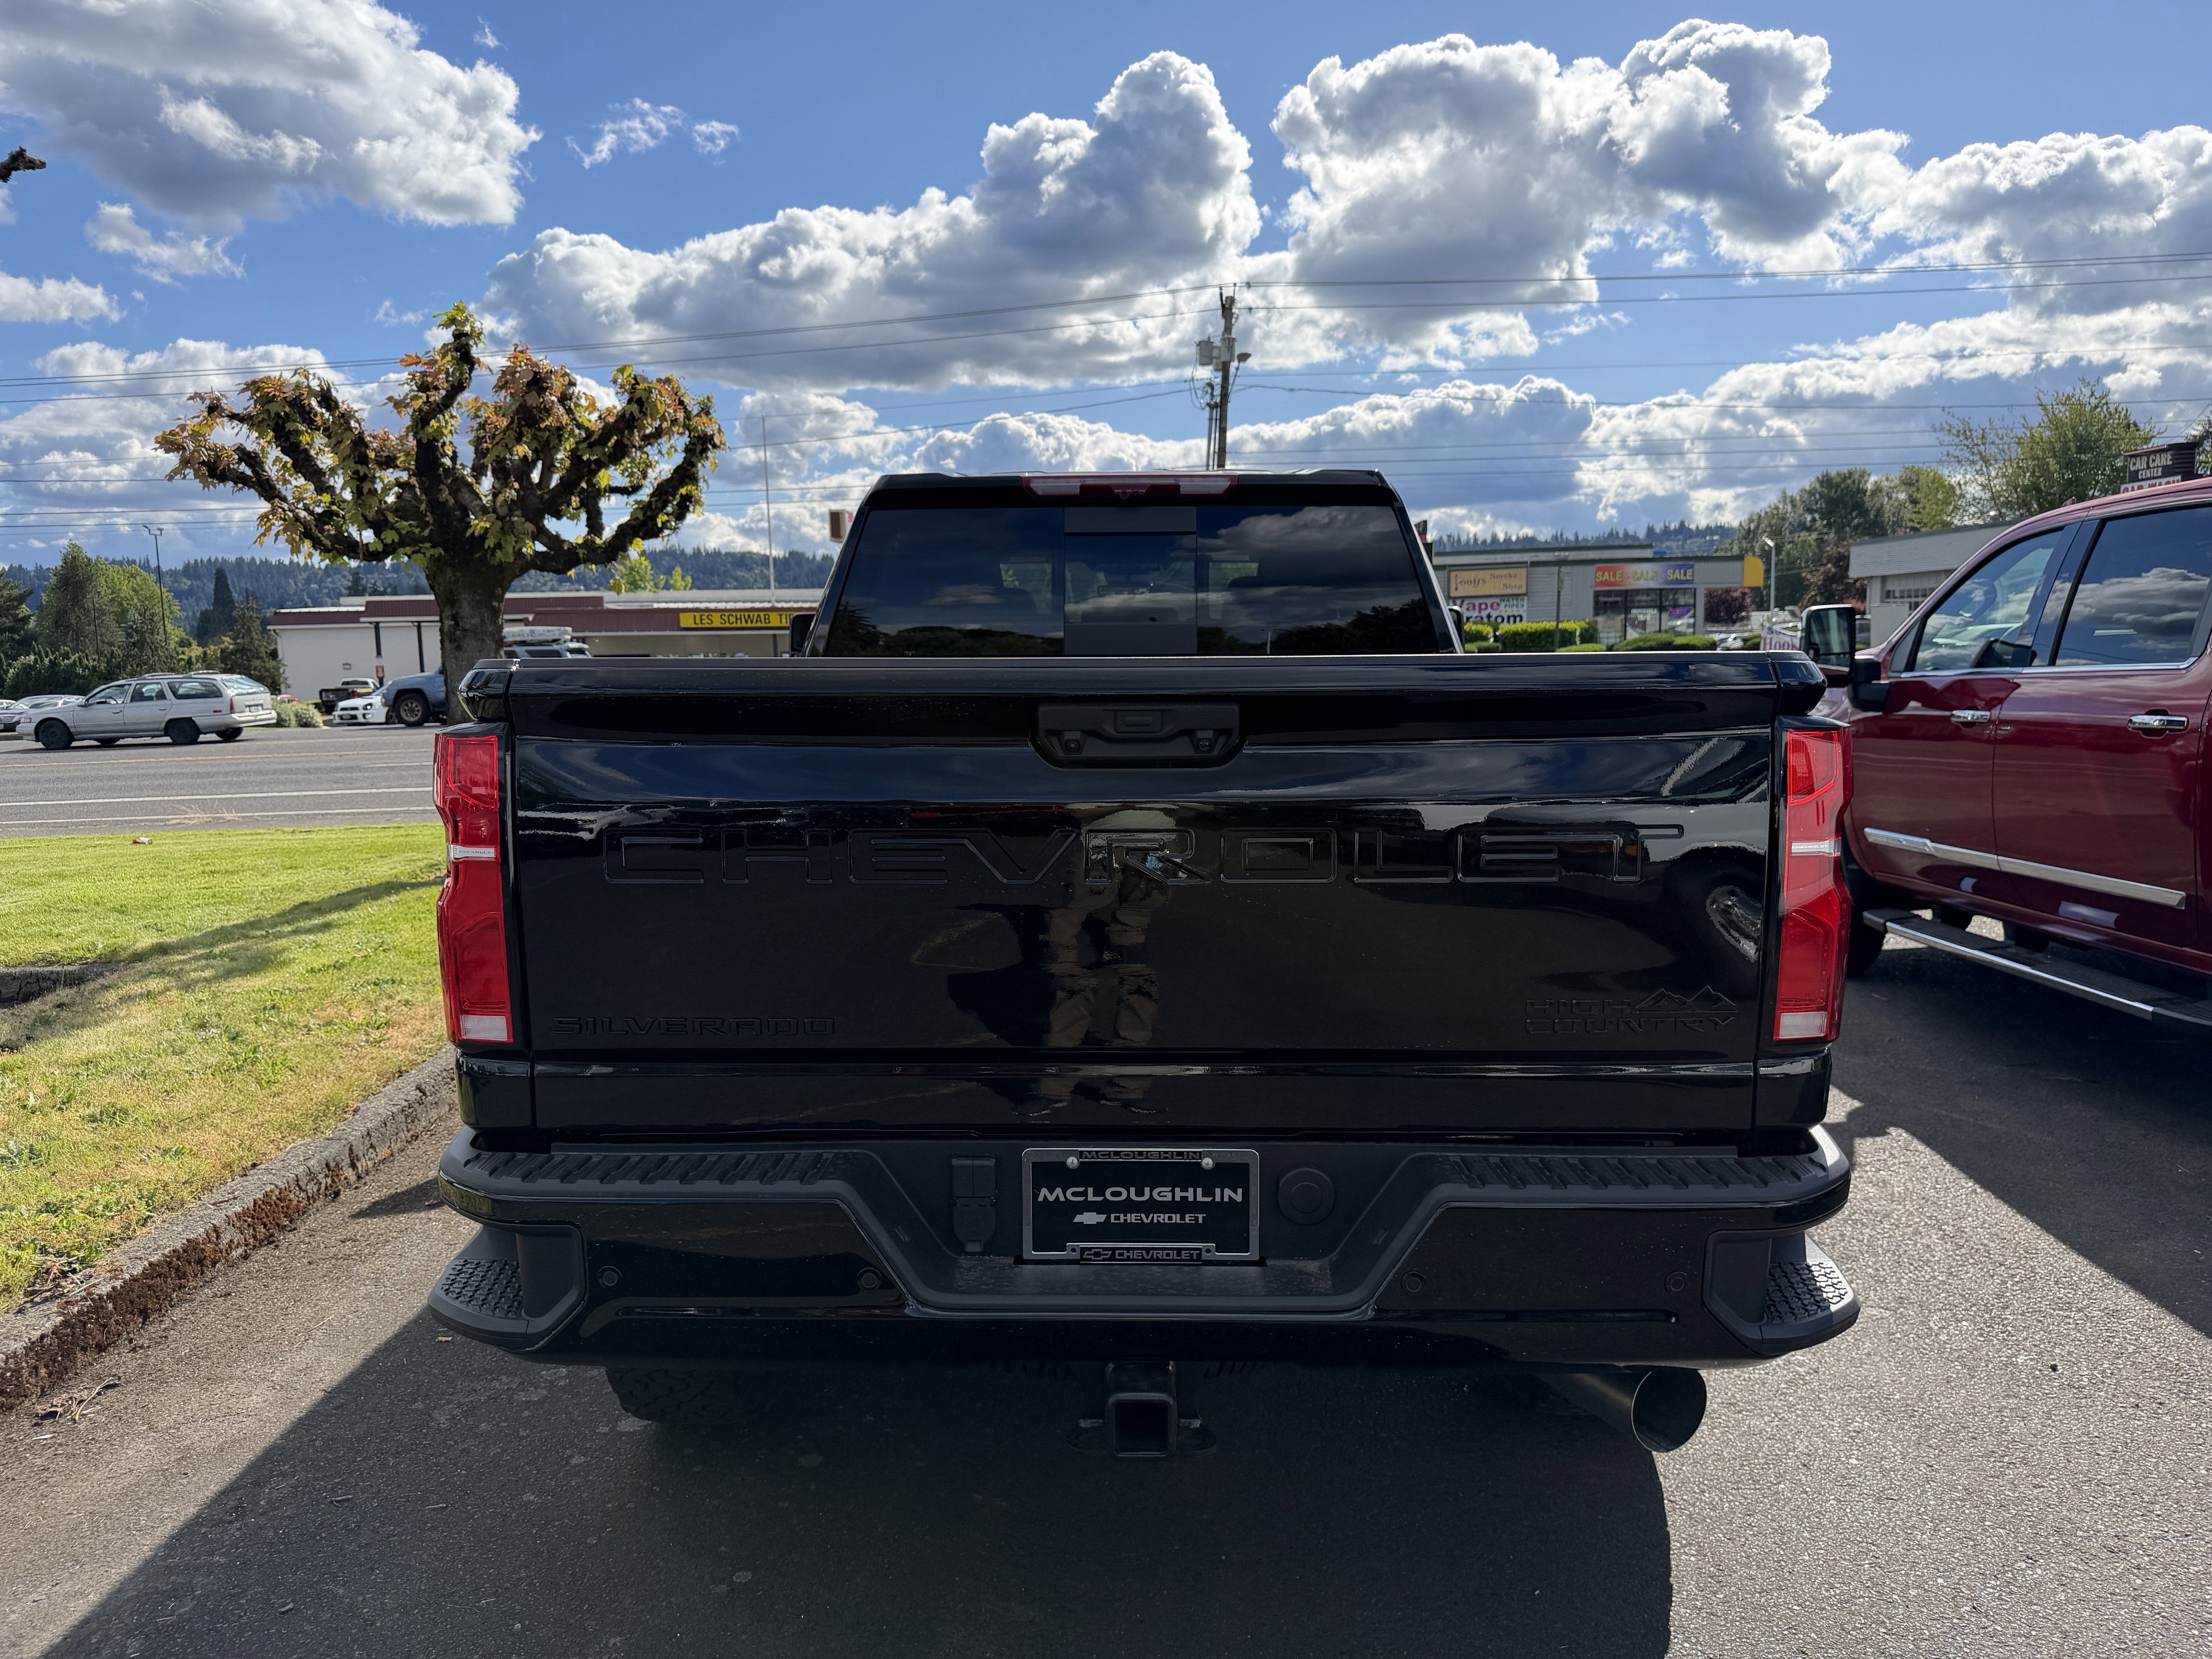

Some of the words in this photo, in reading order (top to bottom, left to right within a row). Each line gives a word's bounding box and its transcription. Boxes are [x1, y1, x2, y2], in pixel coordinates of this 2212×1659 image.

[2130, 456, 2147, 471] CAR
[2150, 451, 2172, 468] CARE
[2138, 467, 2162, 479] CENTER
[1596, 570, 1623, 582] SALE
[1632, 570, 1658, 580] SALE
[1667, 568, 1693, 580] SALE
[1452, 599, 1500, 614] Vape
[693, 613, 713, 625] LES
[720, 613, 771, 625] SCHWAB
[1466, 612, 1523, 624] ratom
[603, 825, 1684, 885] CHEVROLET
[1525, 999, 1631, 1015] HIGH
[552, 1017, 835, 1036] SILVERADO
[1525, 1017, 1736, 1034] COUNTRY
[1082, 1151, 1200, 1160] MCLOUGHLIN
[1037, 1187, 1242, 1202] MCLOUGHLIN
[1110, 1213, 1206, 1223] CHEVROLET
[1115, 1250, 1200, 1259] CHEVROLET
